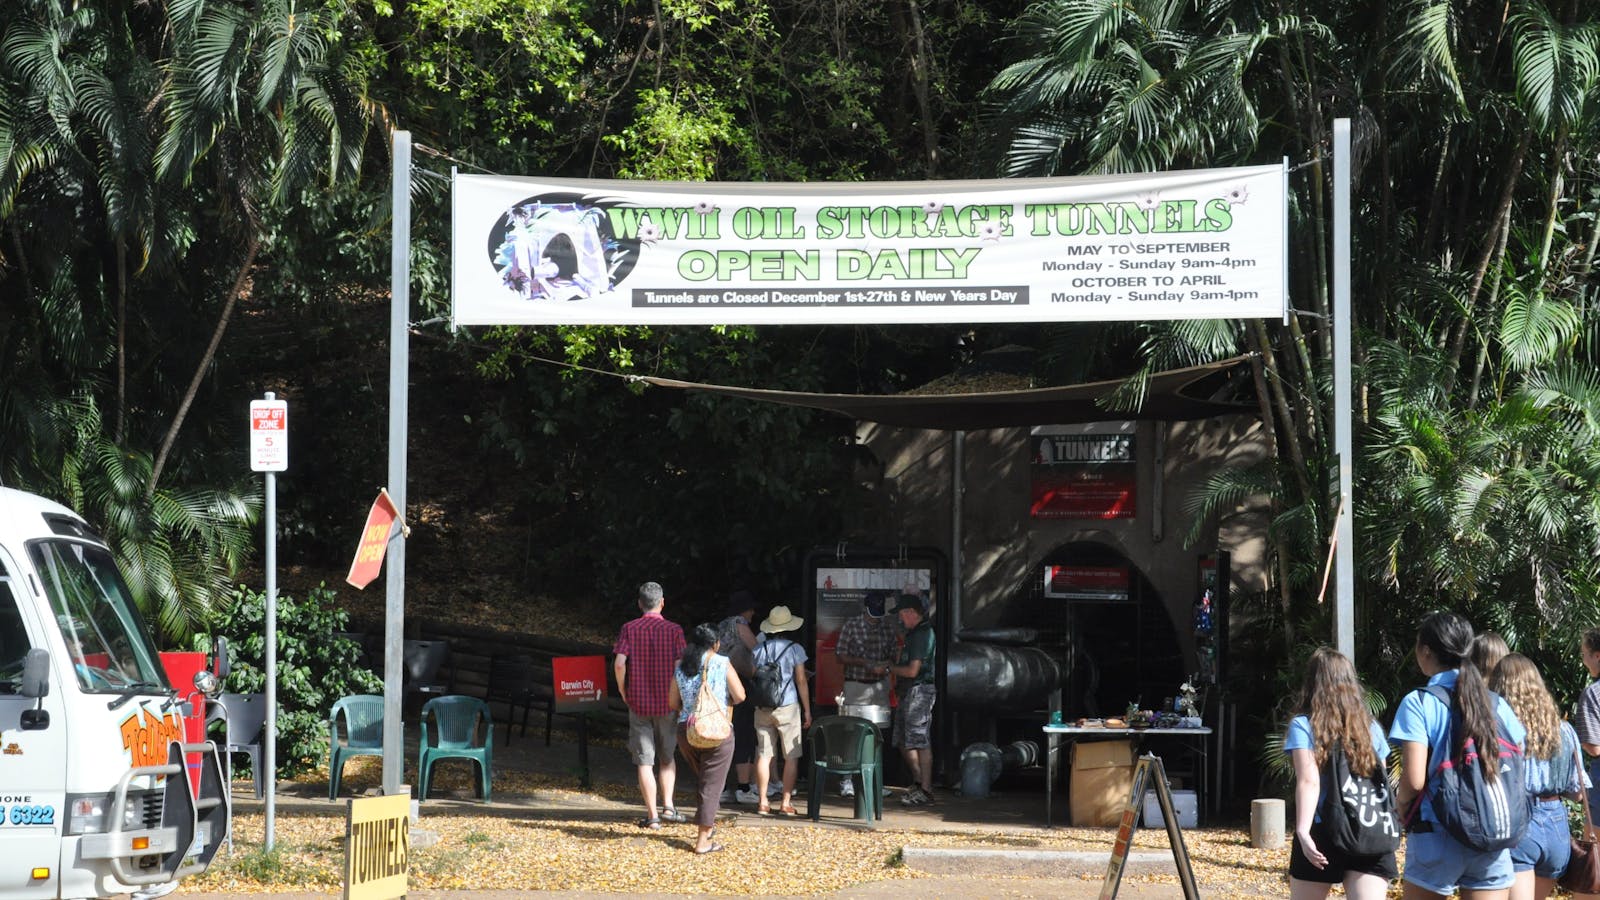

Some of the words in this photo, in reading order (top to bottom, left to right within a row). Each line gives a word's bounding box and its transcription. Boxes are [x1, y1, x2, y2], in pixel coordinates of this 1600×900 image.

[606, 207, 721, 240] WWII
[733, 206, 805, 240] OIL
[816, 204, 1013, 239] STORAGE
[1025, 198, 1233, 236] TUNNELS
[1067, 245, 1102, 256] MAY
[1108, 244, 1131, 255] TO
[1135, 242, 1230, 254] SEPTEMBER
[677, 250, 820, 281] OPEN
[837, 248, 983, 280] DAILY
[1042, 261, 1103, 272] Monday
[1119, 259, 1176, 271] Sunday
[1181, 257, 1256, 269] 9am-4pm
[1072, 277, 1147, 288] OCTOBER
[1152, 276, 1174, 286] TO
[1180, 275, 1226, 286] APRIL
[644, 291, 694, 303] Tunnels
[697, 293, 719, 303] are
[723, 291, 768, 304] Closed
[772, 291, 840, 303] December
[844, 291, 897, 303] 1st-27th
[901, 291, 911, 302] &
[915, 290, 946, 302] New
[950, 289, 987, 301] Years
[990, 289, 1017, 303] Day
[1051, 292, 1111, 304] Monday
[1128, 291, 1185, 302] Sunday
[1190, 289, 1258, 301] 9am-1pm
[253, 410, 269, 419] DROP
[271, 410, 284, 419] OFF
[259, 420, 279, 429] ZONE
[265, 437, 274, 446] 5
[1055, 440, 1130, 460] TUNNELS
[366, 524, 390, 541] NOW
[358, 543, 385, 563] OPEN
[561, 680, 582, 690] Darwin
[582, 680, 594, 690] City
[10, 805, 55, 825] 6322
[352, 815, 409, 885] TUNNELS
